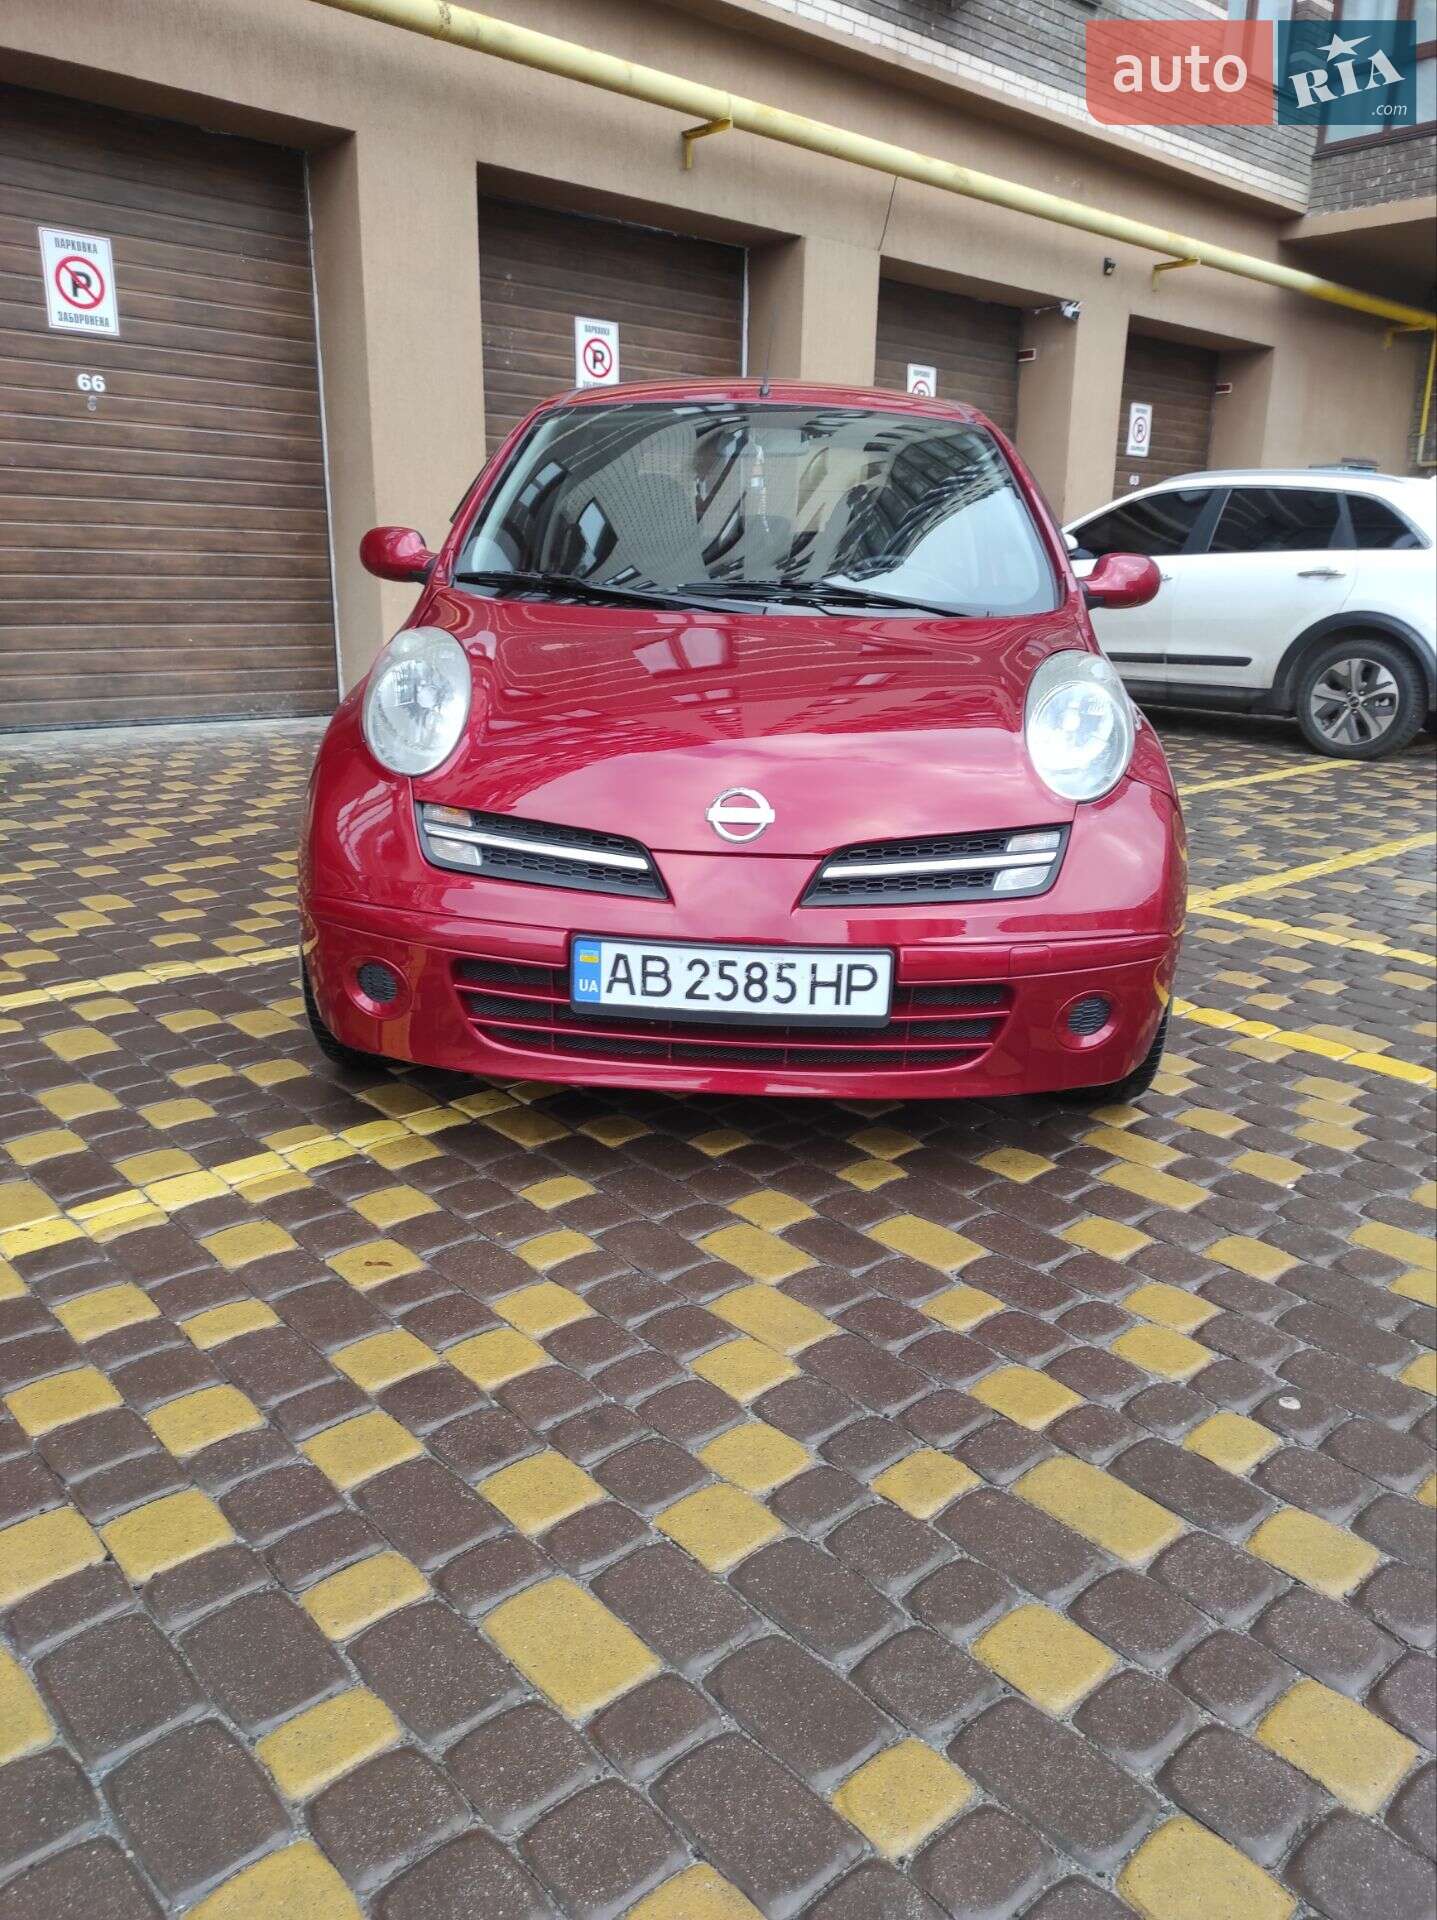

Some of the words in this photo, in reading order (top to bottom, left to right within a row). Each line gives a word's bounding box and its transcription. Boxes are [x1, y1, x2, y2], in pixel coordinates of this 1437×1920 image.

[54, 237, 99, 255] ПАРКОВКА
[57, 310, 110, 328] ЗАБОРОНЕНА
[76, 372, 107, 393] 66
[578, 978, 599, 993] UA
[606, 952, 673, 998] AB
[684, 957, 797, 1005] 2585
[808, 962, 879, 1006] HP
